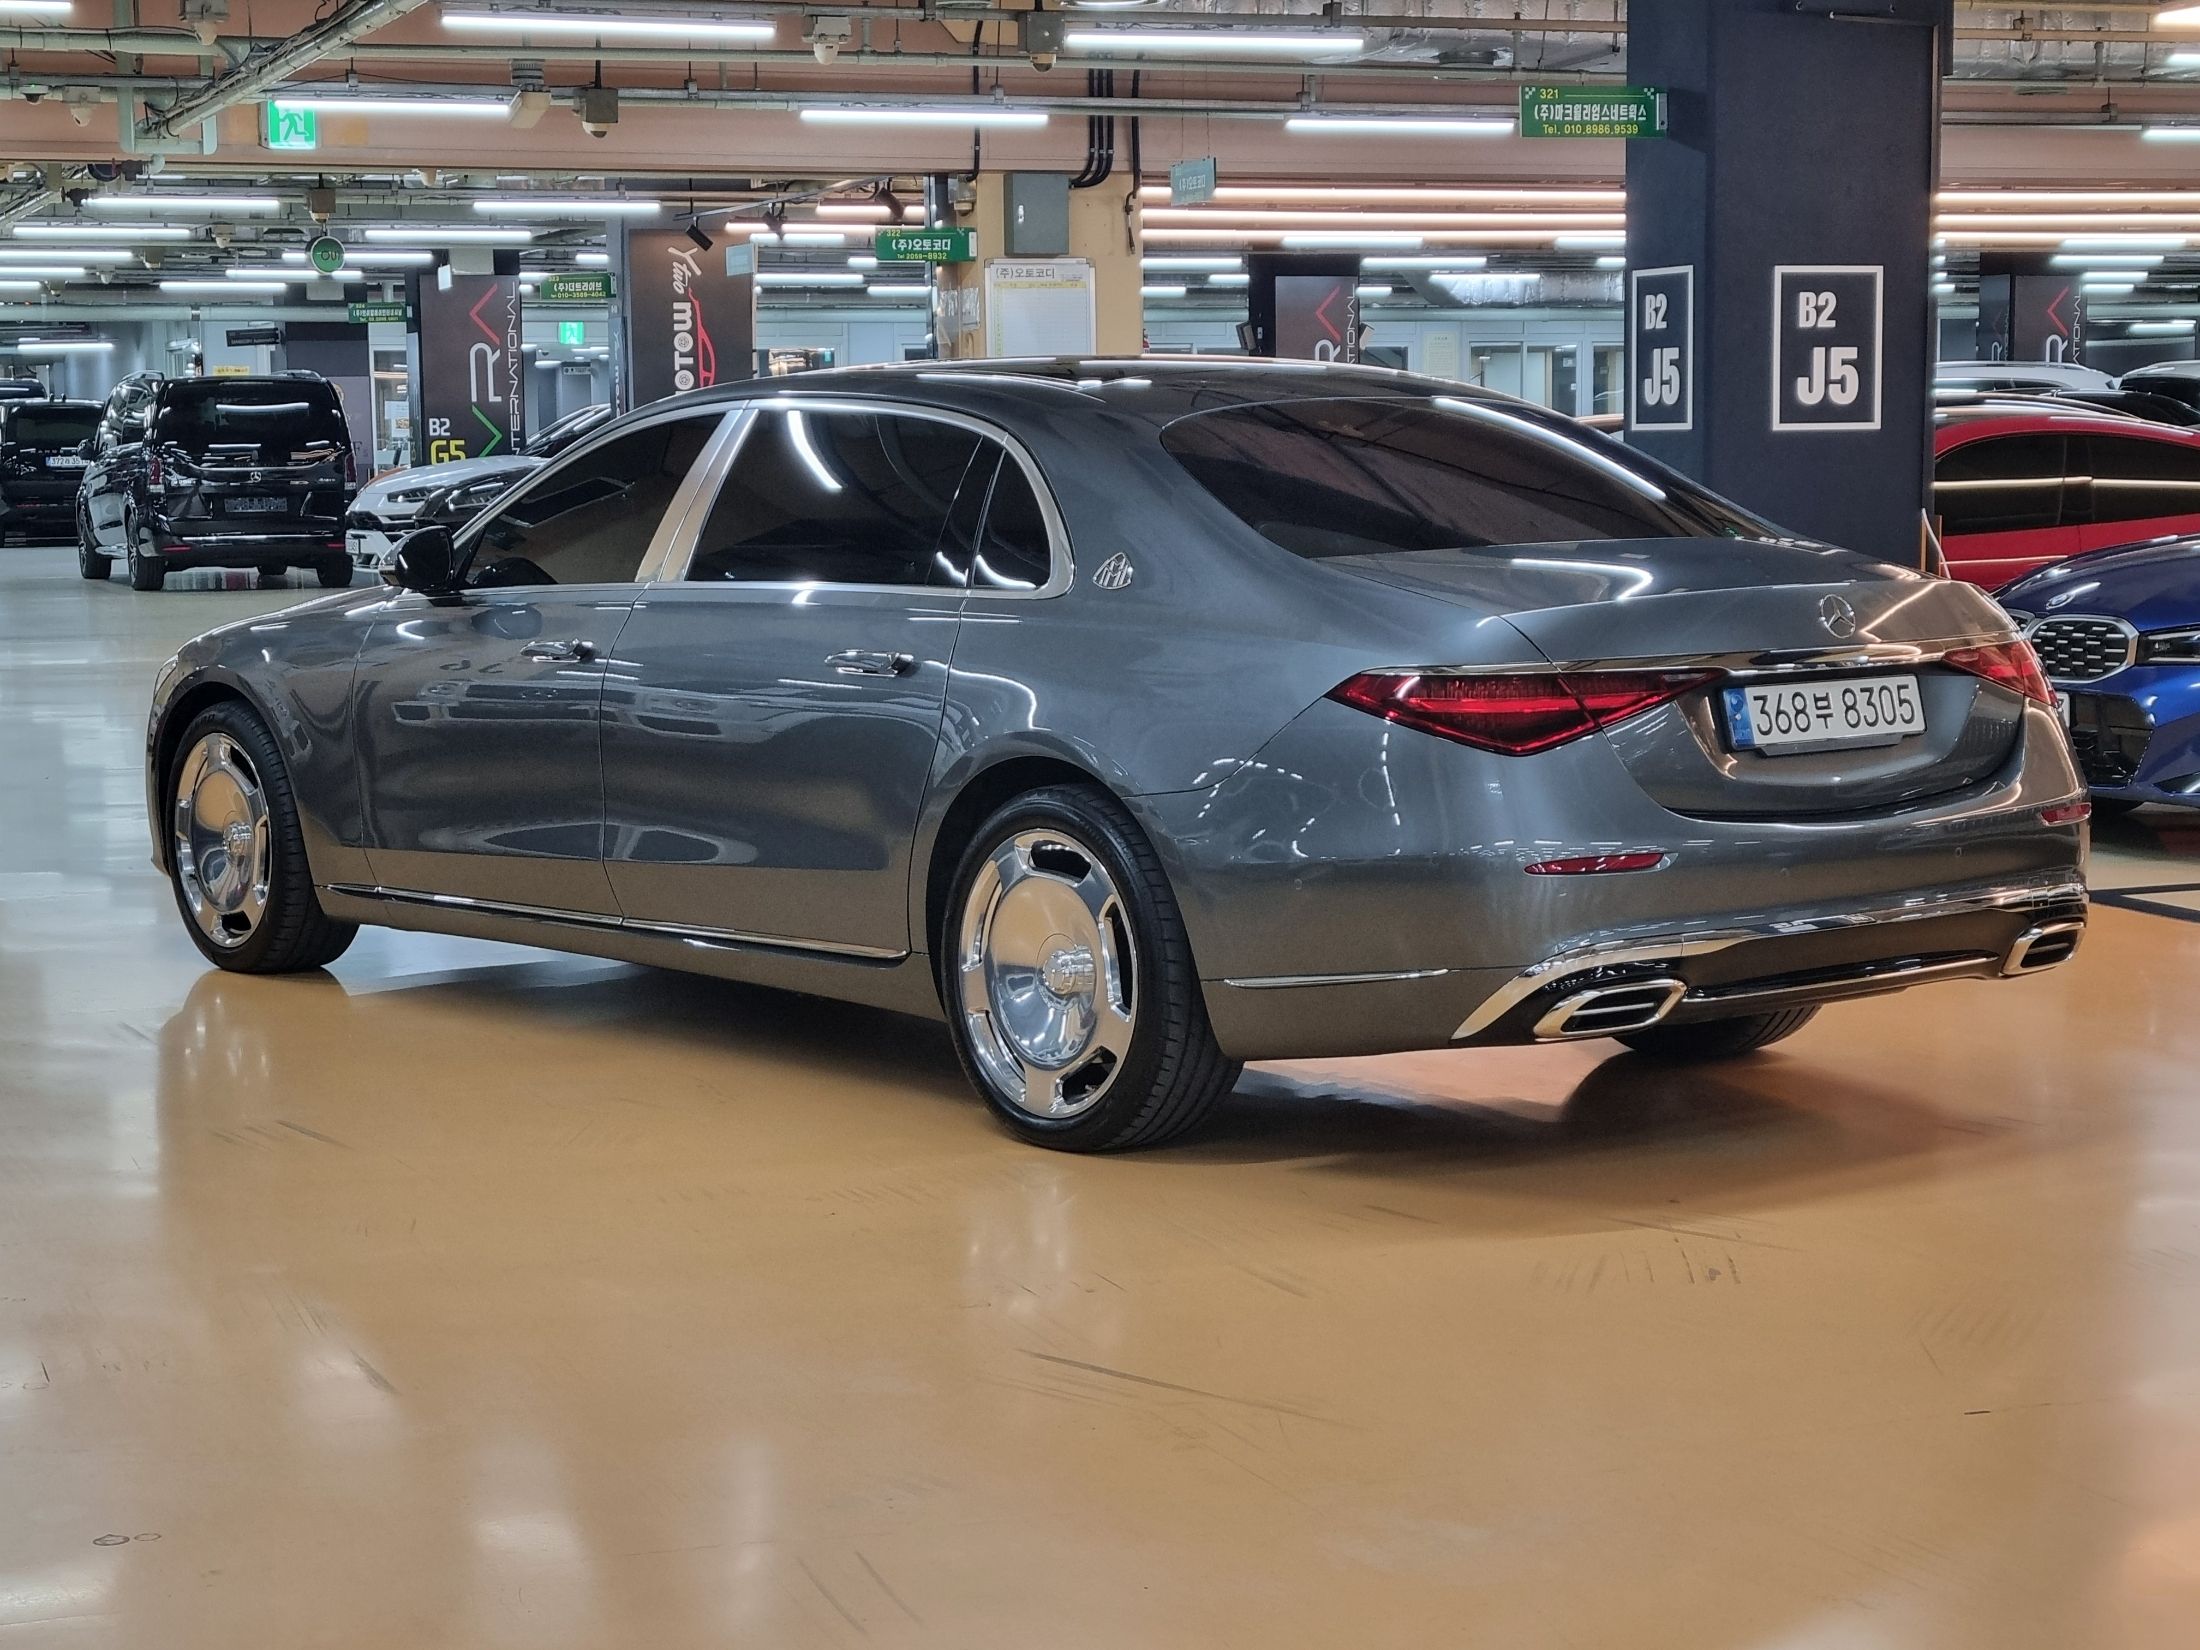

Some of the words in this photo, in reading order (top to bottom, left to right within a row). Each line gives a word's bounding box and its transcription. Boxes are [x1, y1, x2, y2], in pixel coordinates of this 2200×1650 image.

[1540, 88, 1559, 99] 321
[1543, 124, 1561, 135] Tel.
[1564, 124, 1639, 135] 010.8986.9539
[886, 229, 901, 237] 322
[891, 238, 952, 251] (주)오토코디
[995, 267, 1055, 279] (주)오토코디
[1645, 294, 1668, 330] B2
[1798, 291, 1837, 328] B2
[1644, 347, 1680, 405] J5
[1798, 347, 1859, 405] J5
[429, 418, 450, 436] B2
[431, 439, 466, 465] G5
[1753, 691, 1834, 736] 368부
[1841, 684, 1915, 728] 8305
